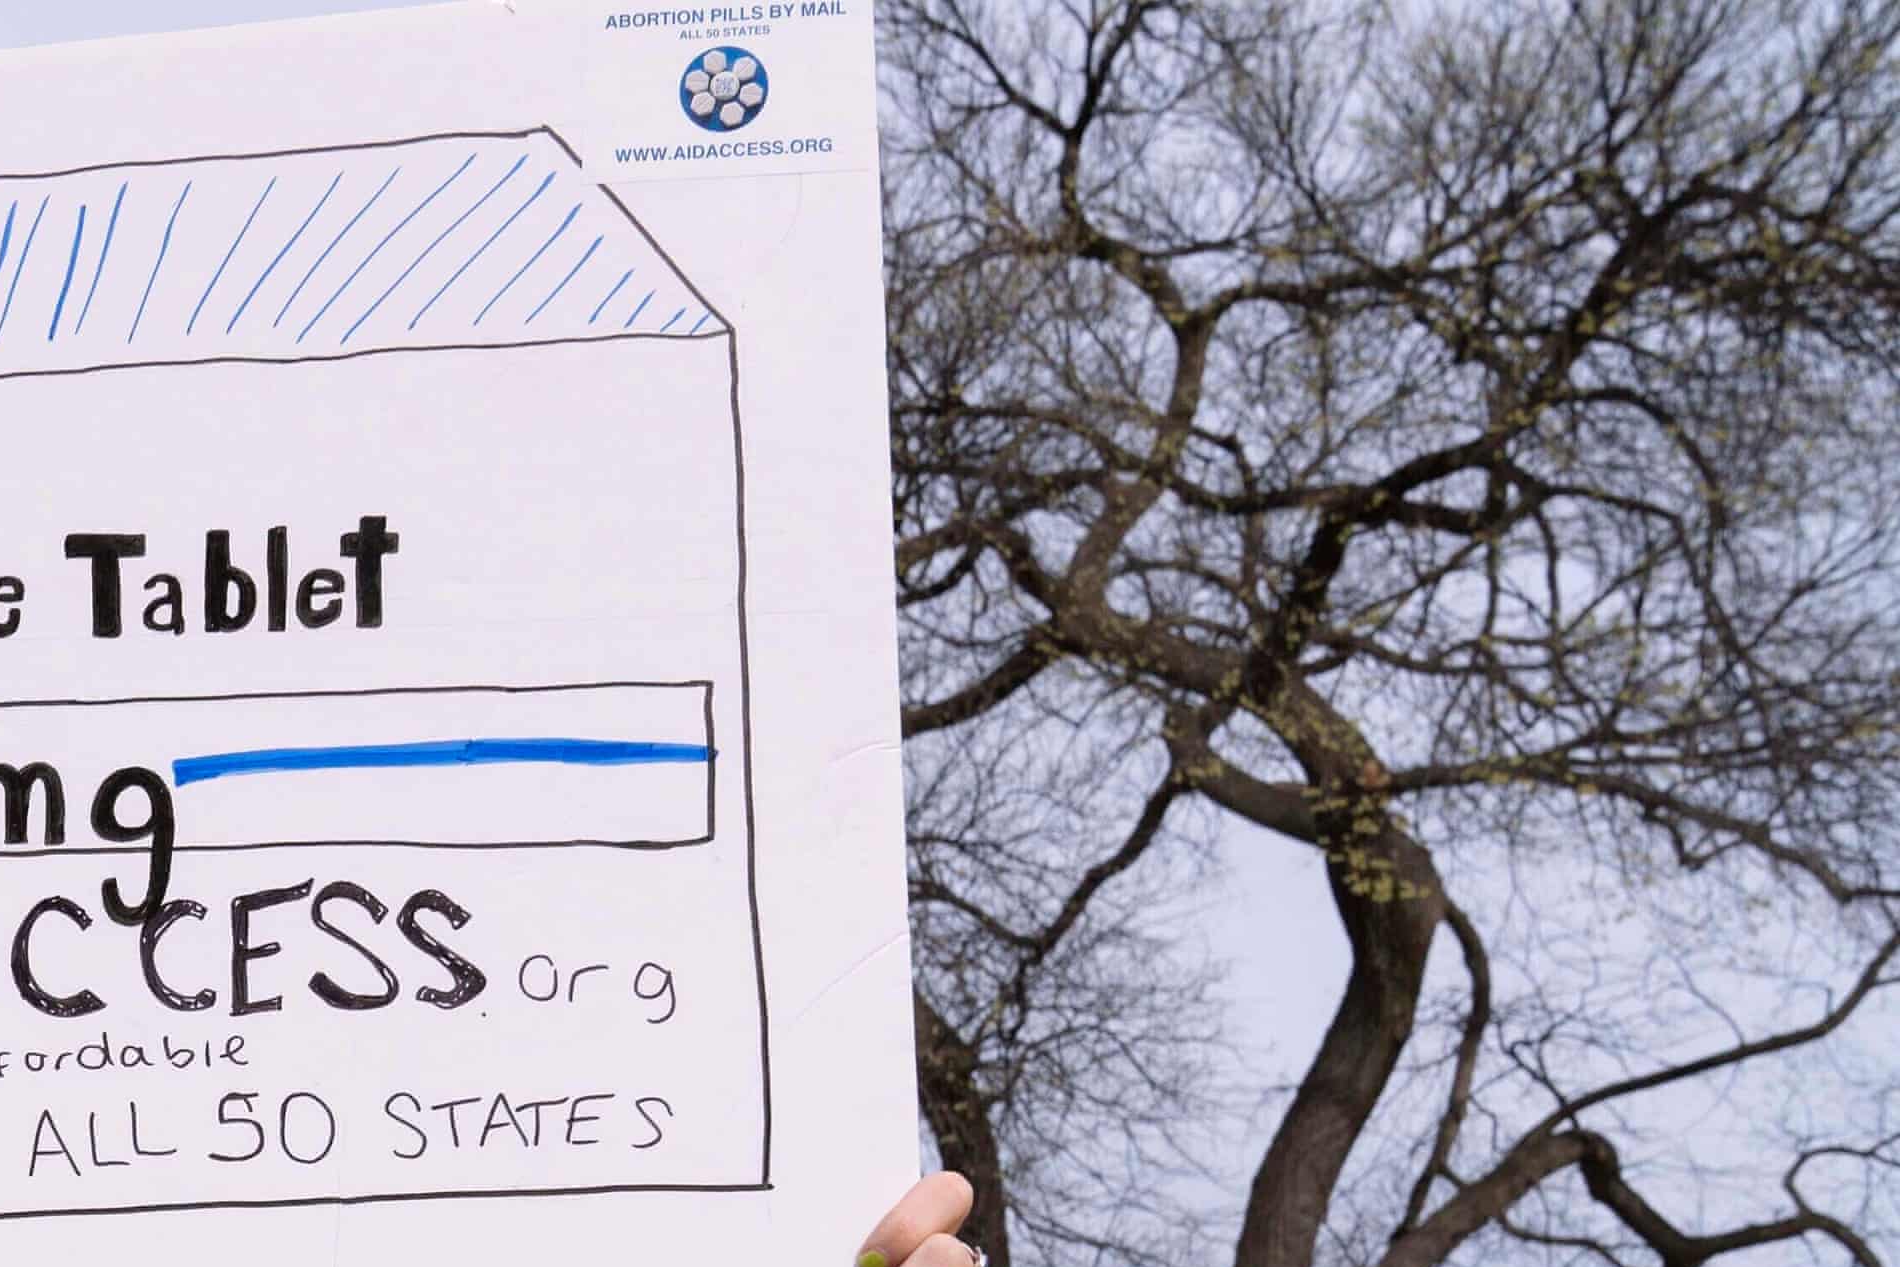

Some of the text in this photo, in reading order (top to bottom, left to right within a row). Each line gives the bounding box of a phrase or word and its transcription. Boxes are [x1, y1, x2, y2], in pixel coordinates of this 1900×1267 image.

[605, 0, 848, 29] ABORTION PILLS BY MAIL
[679, 24, 771, 40] ALL 50 STATES
[615, 138, 833, 163] WWW.AIDACCESS.ORG
[64, 515, 399, 638] Tablet
[29, 1101, 177, 1177] ALL
[209, 1091, 336, 1164] 50
[384, 1091, 674, 1159] STATES
